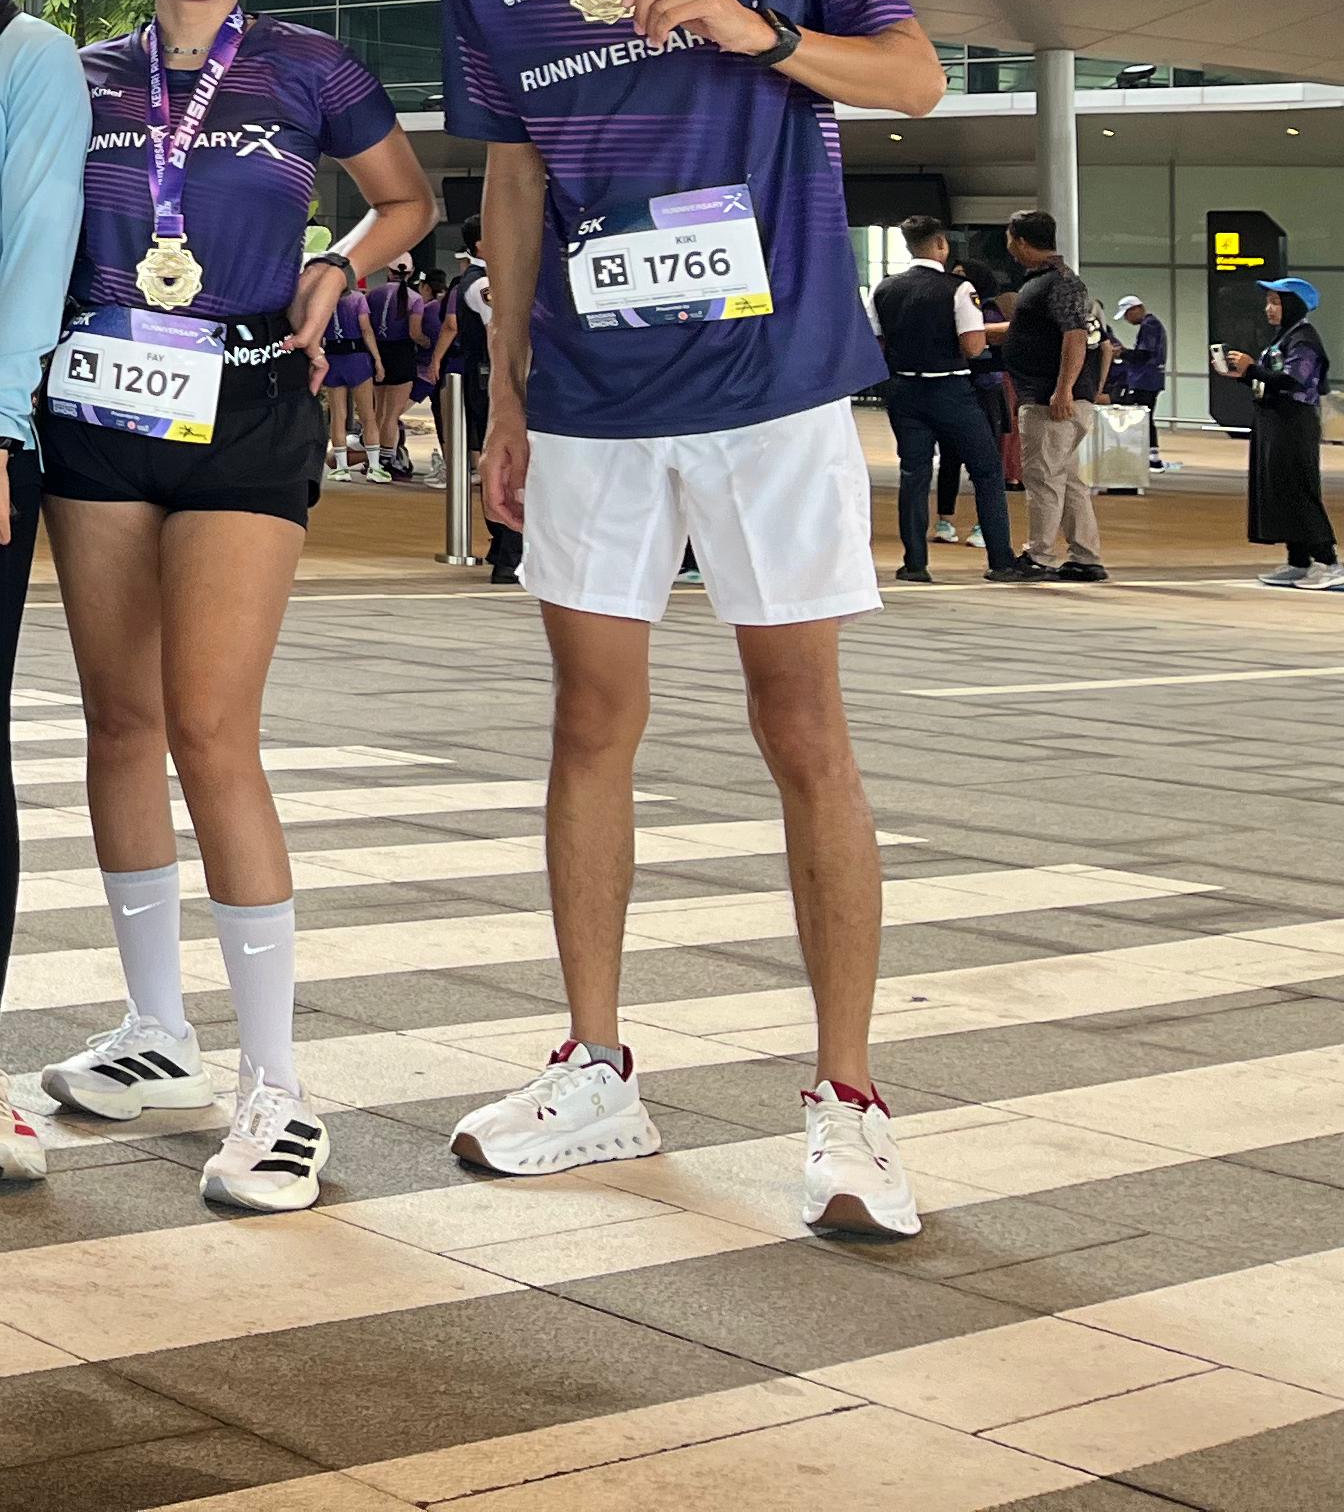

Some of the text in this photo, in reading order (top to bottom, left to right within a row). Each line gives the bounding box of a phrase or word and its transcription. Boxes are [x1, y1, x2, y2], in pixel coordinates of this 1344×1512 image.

[168, 59, 225, 169] FINISHER
[578, 216, 606, 235] 5K
[675, 235, 696, 245] KIKI
[643, 248, 731, 284] 1766
[146, 352, 165, 361] FAY
[112, 363, 190, 399] 1207
